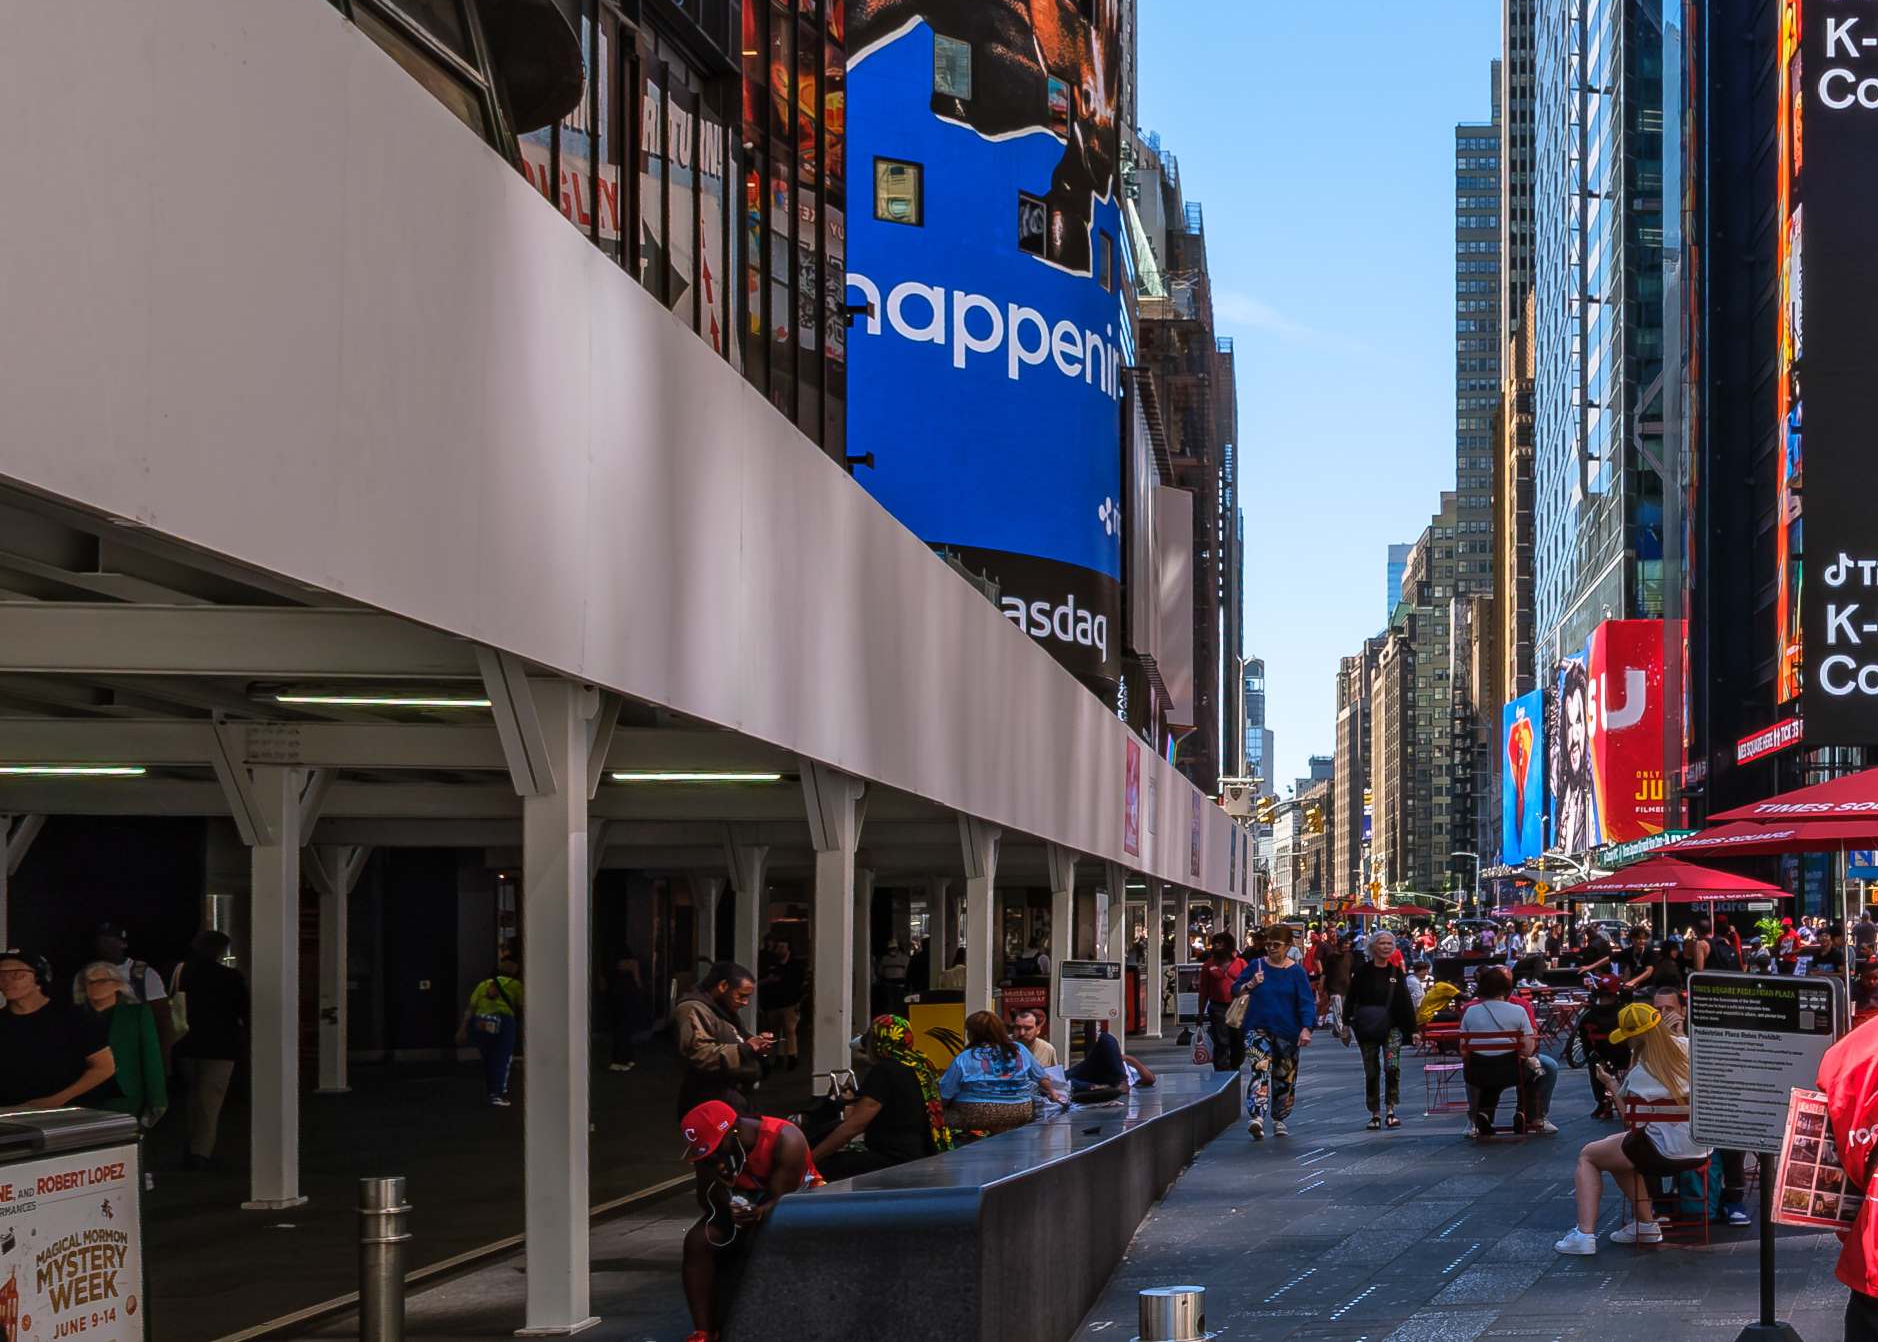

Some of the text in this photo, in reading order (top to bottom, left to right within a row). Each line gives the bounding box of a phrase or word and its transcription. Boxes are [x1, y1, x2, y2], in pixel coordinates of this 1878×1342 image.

[1002, 595, 1107, 663] asdaq
[1754, 803, 1834, 813] TIMES
[1675, 830, 1795, 847] TIMES SQUARE
[18, 1188, 35, 1199] AND
[36, 1170, 86, 1195] ROBERT
[88, 1162, 126, 1185] LOPEZ
[36, 1228, 128, 1267] MAGICAL MORMON
[37, 1244, 128, 1294] MYSTERY
[50, 1270, 119, 1314] WEEK
[53, 1307, 117, 1340] JUNE 9-14
